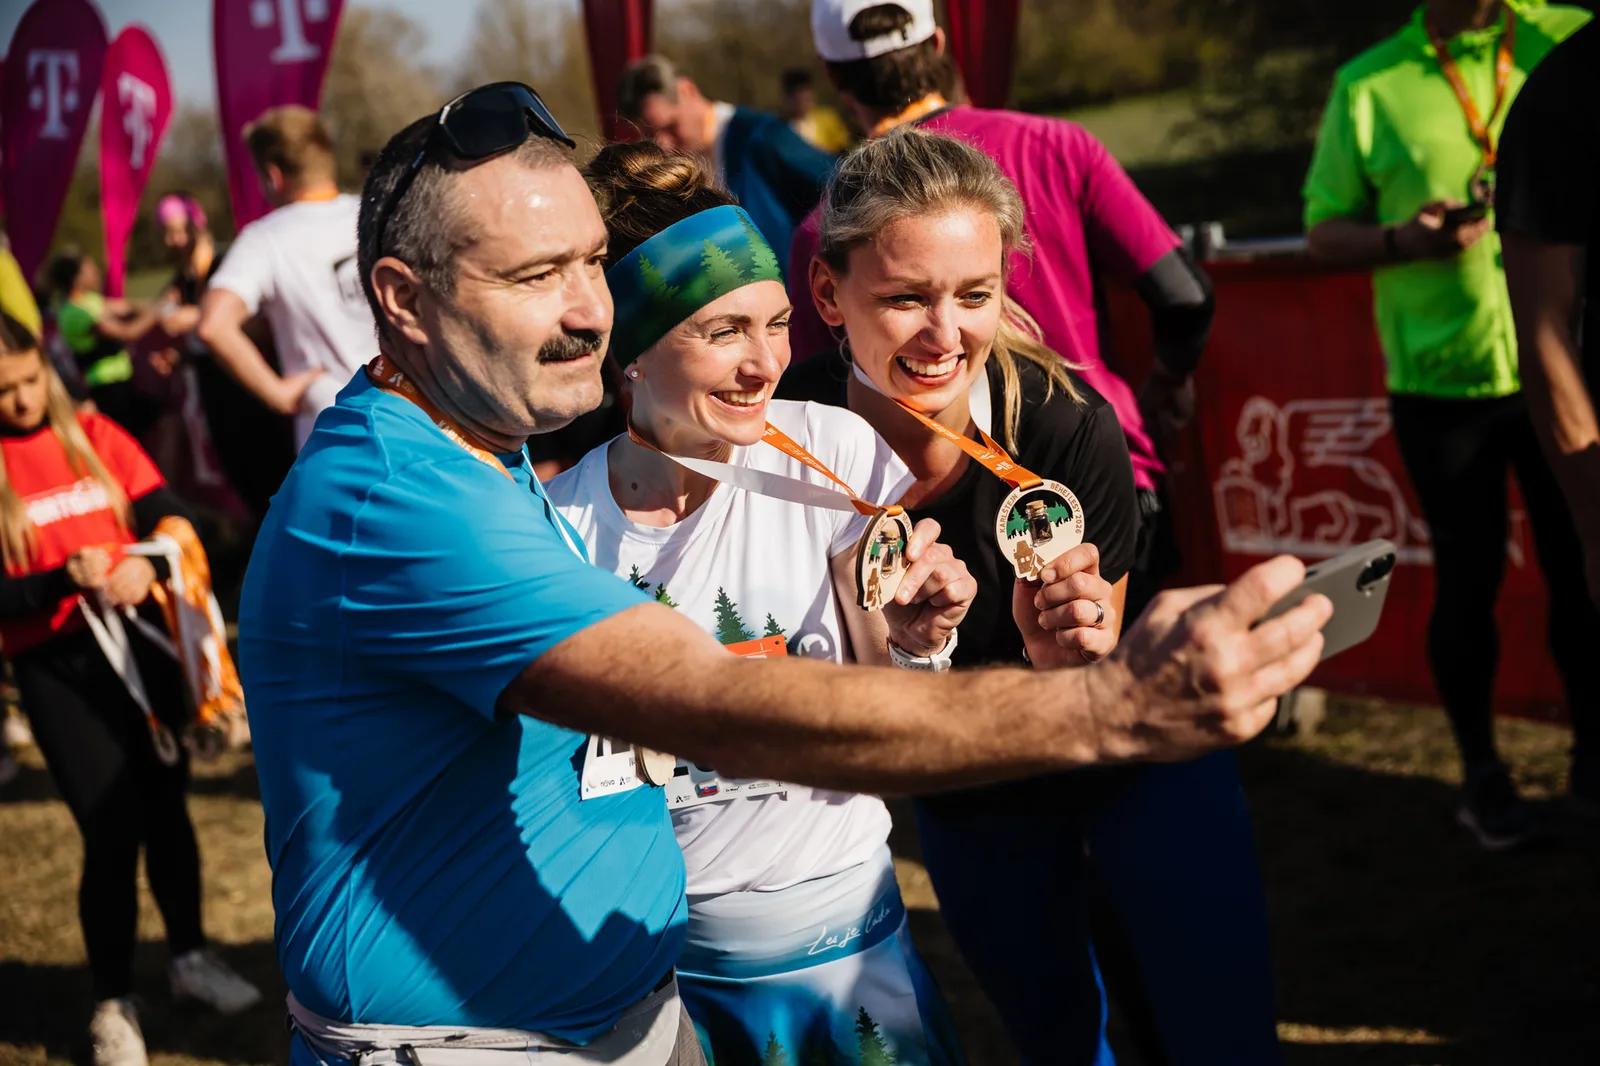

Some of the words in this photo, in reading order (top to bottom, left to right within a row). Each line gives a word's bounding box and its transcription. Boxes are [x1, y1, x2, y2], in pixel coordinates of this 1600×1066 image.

[27, 50, 79, 138] T
[1068, 494, 1081, 512] LESY
[1075, 513, 1083, 534] 2026
[838, 928, 861, 948] je
